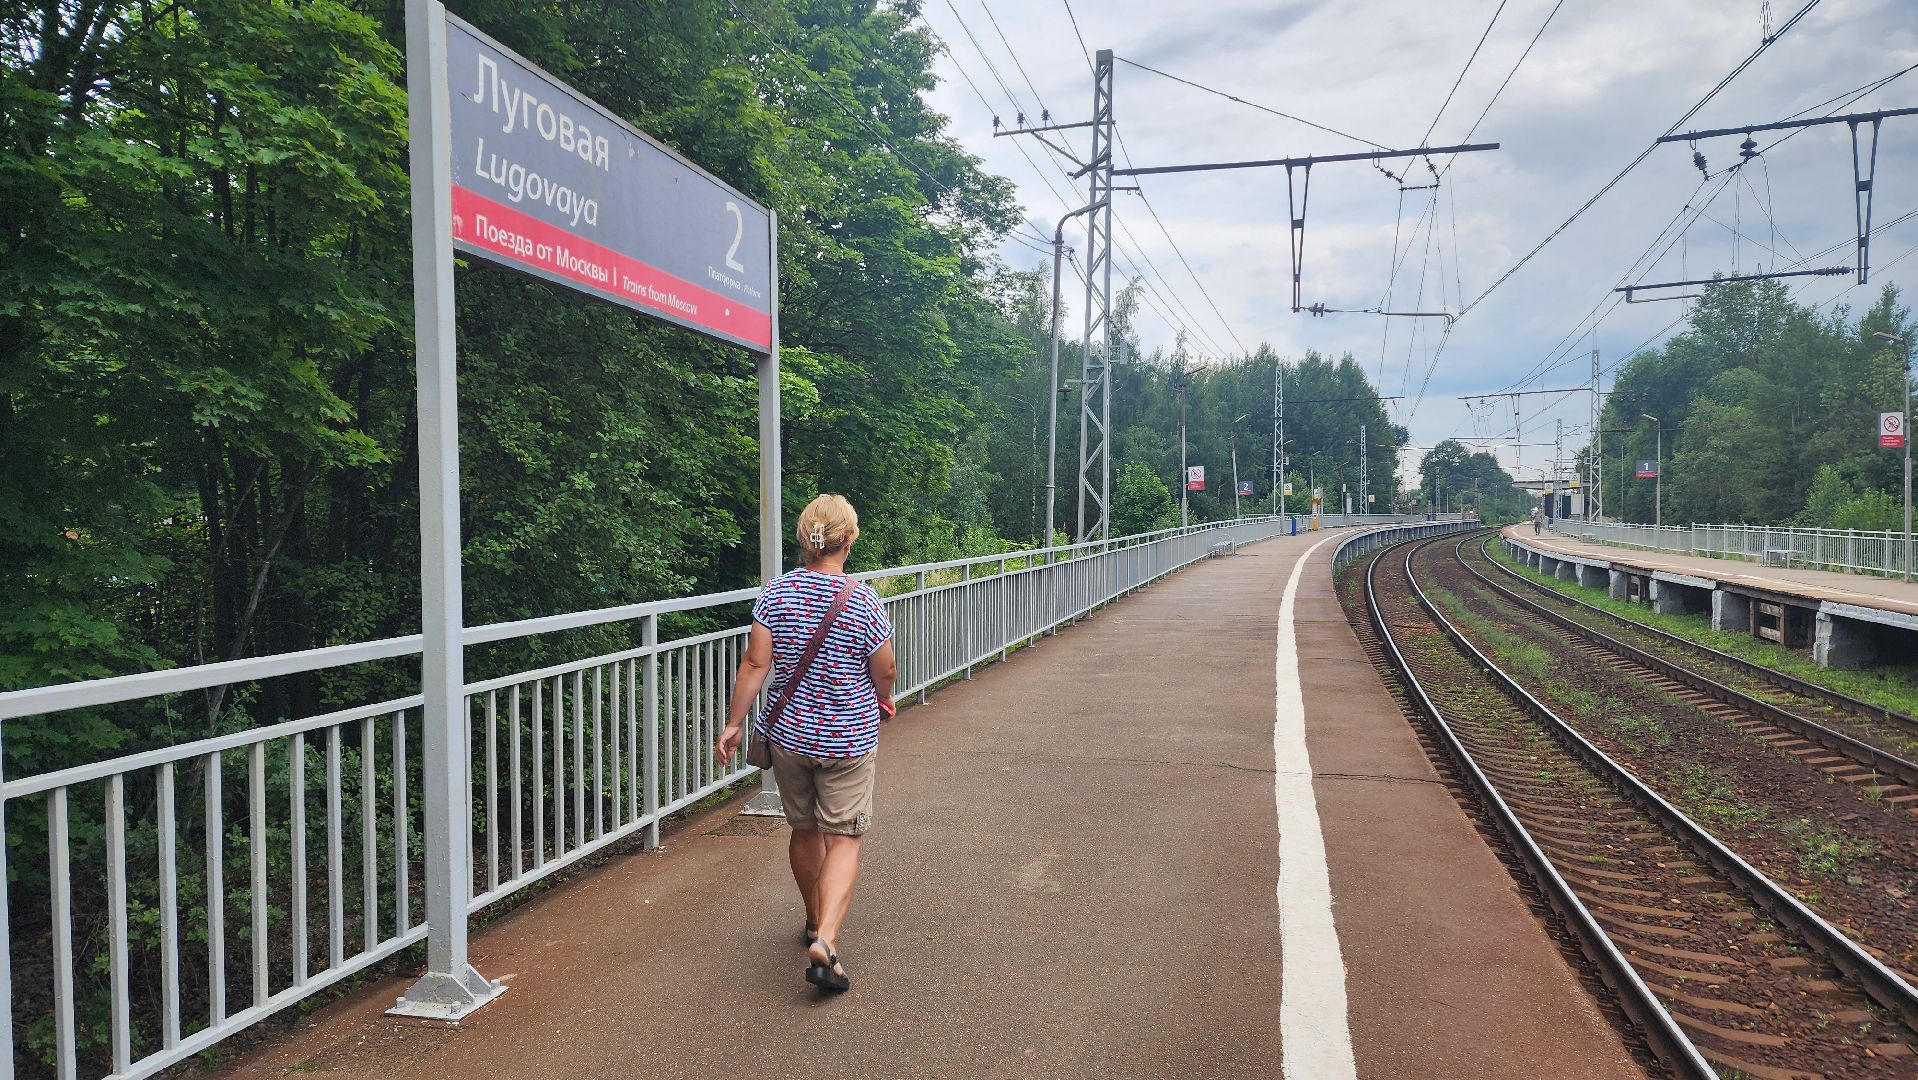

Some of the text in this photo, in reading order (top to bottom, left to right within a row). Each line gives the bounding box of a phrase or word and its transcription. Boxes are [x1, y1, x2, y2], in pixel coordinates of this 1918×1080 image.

[473, 52, 609, 172] Луговая
[475, 137, 598, 227] Lugovaya
[476, 213, 698, 315] Поезда от Москвы Trains from Moscow
[725, 201, 744, 274] 2
[1243, 482, 1249, 490] 2
[1643, 462, 1649, 470] 1
